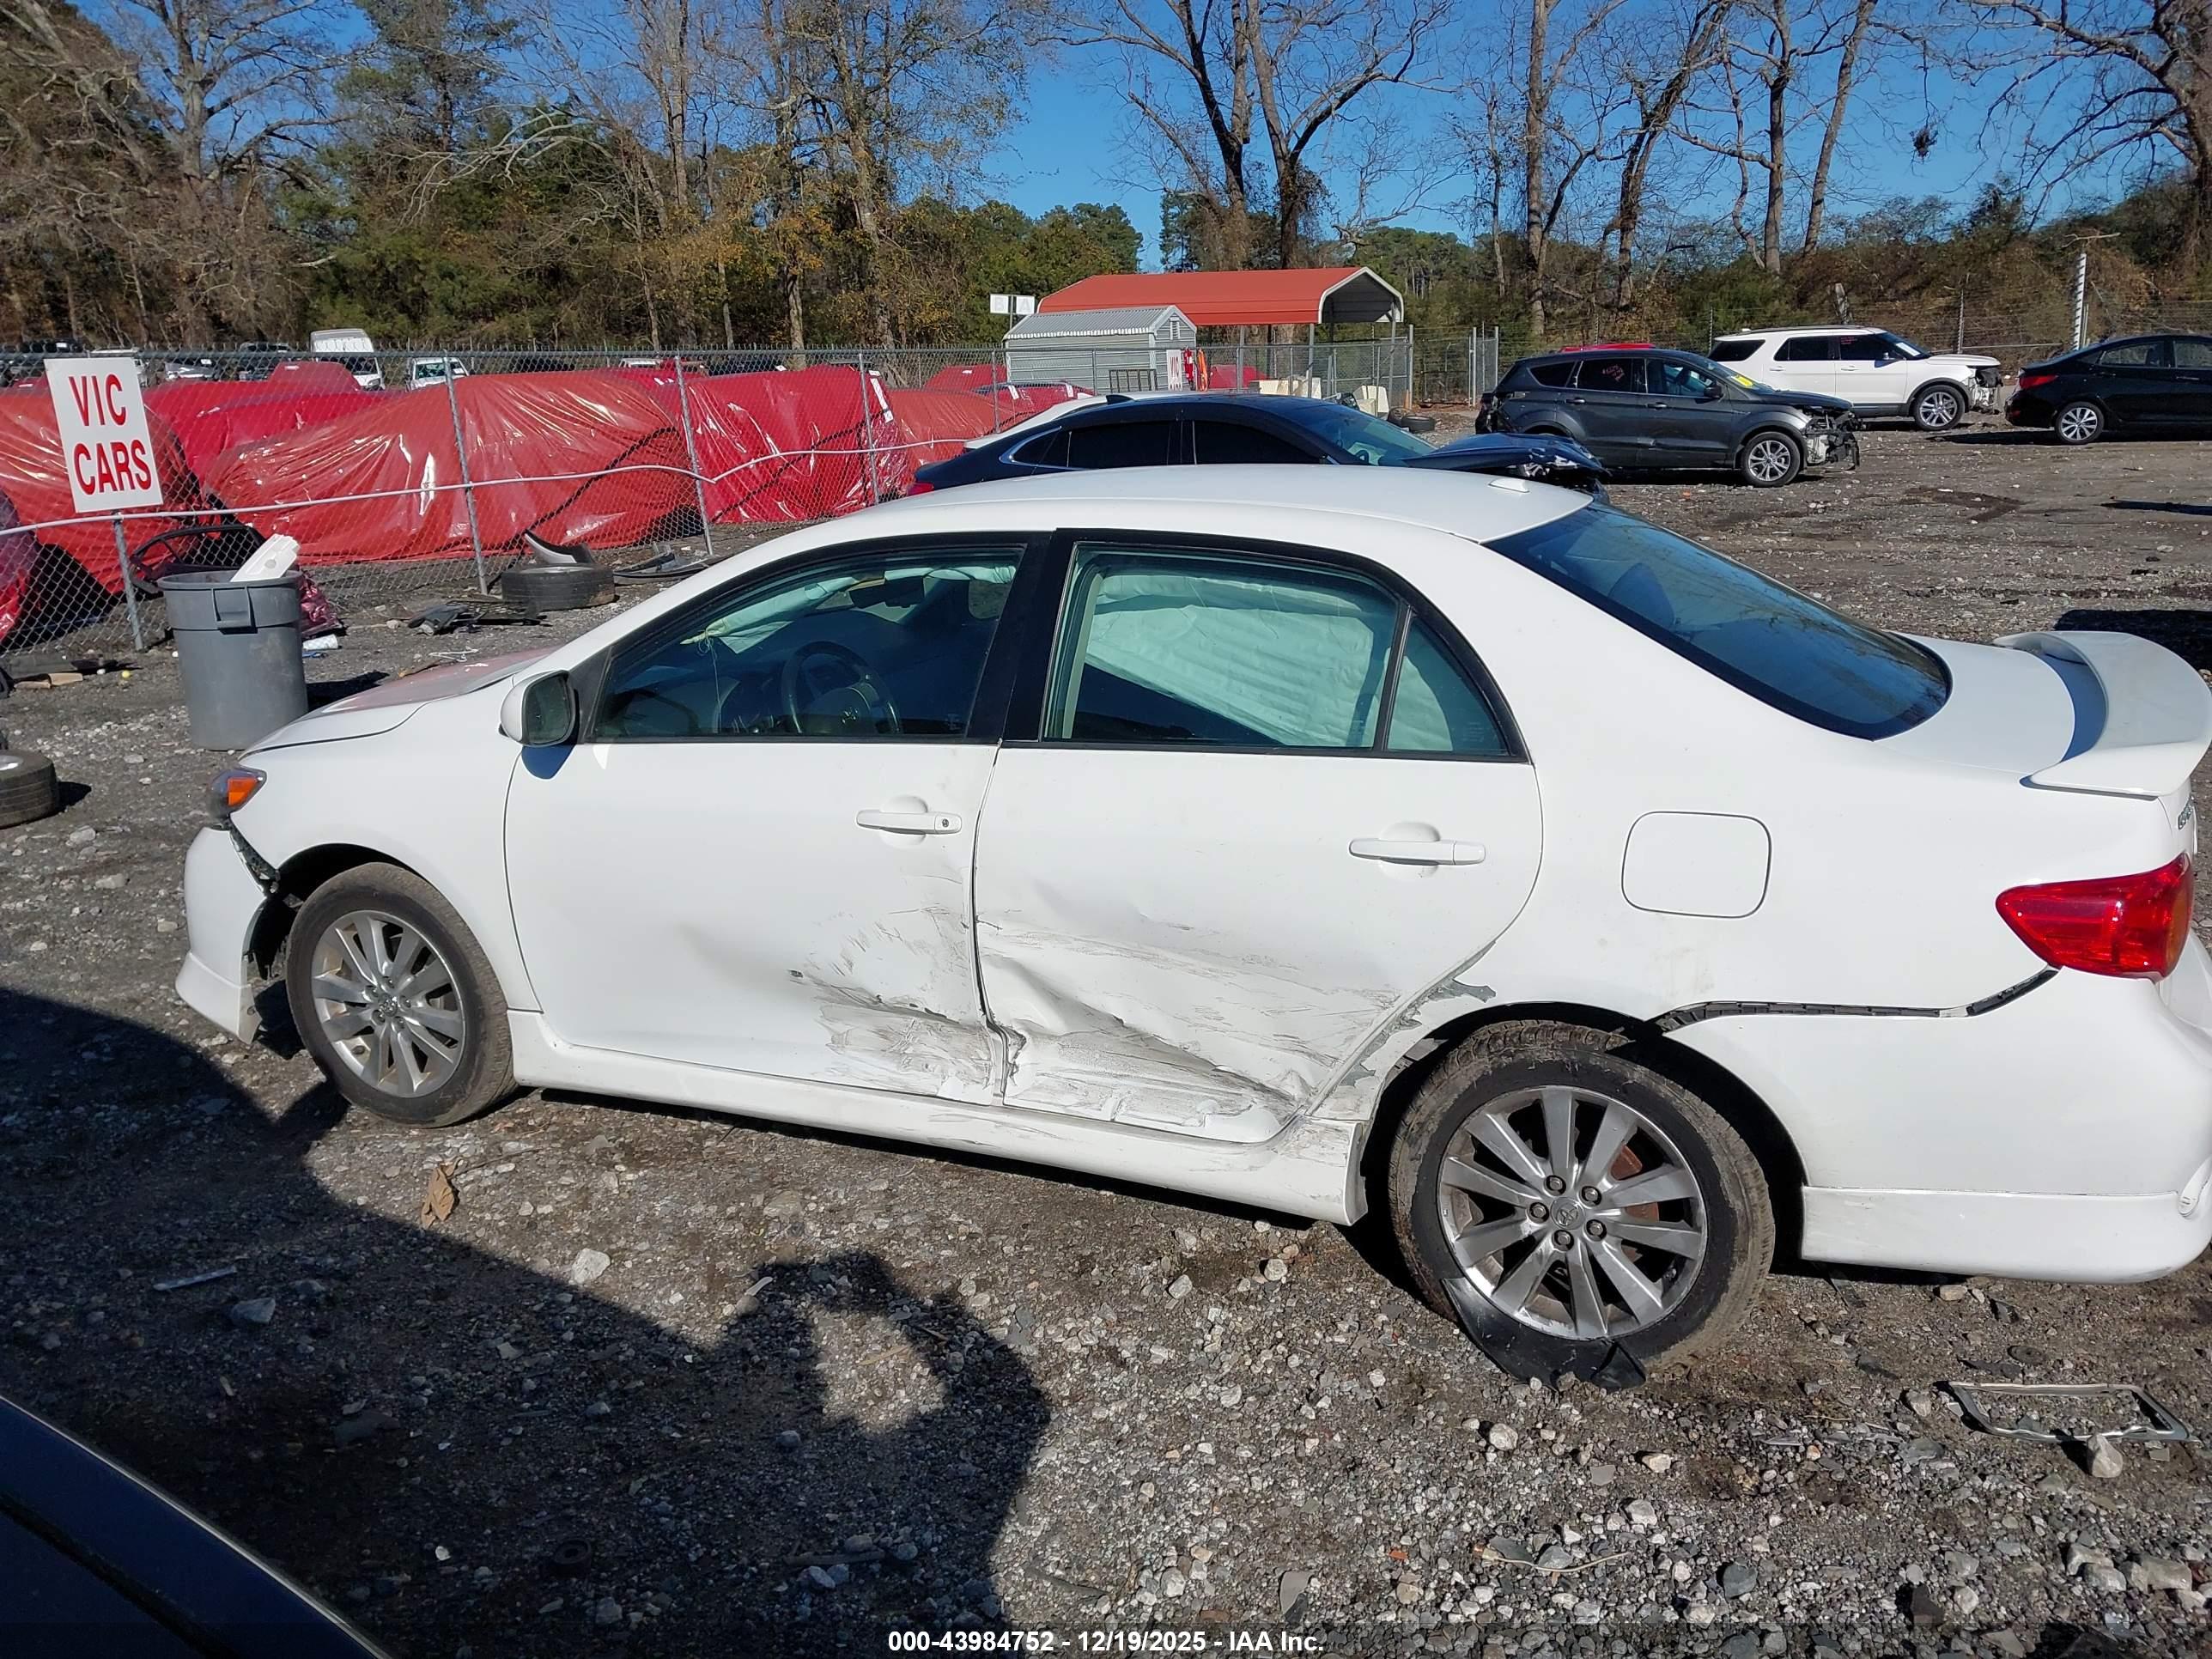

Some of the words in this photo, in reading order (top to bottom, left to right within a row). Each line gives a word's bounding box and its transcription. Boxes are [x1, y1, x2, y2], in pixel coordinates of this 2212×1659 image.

[1018, 298, 1031, 313] A
[68, 374, 126, 427] VIC
[73, 439, 152, 495] CARS
